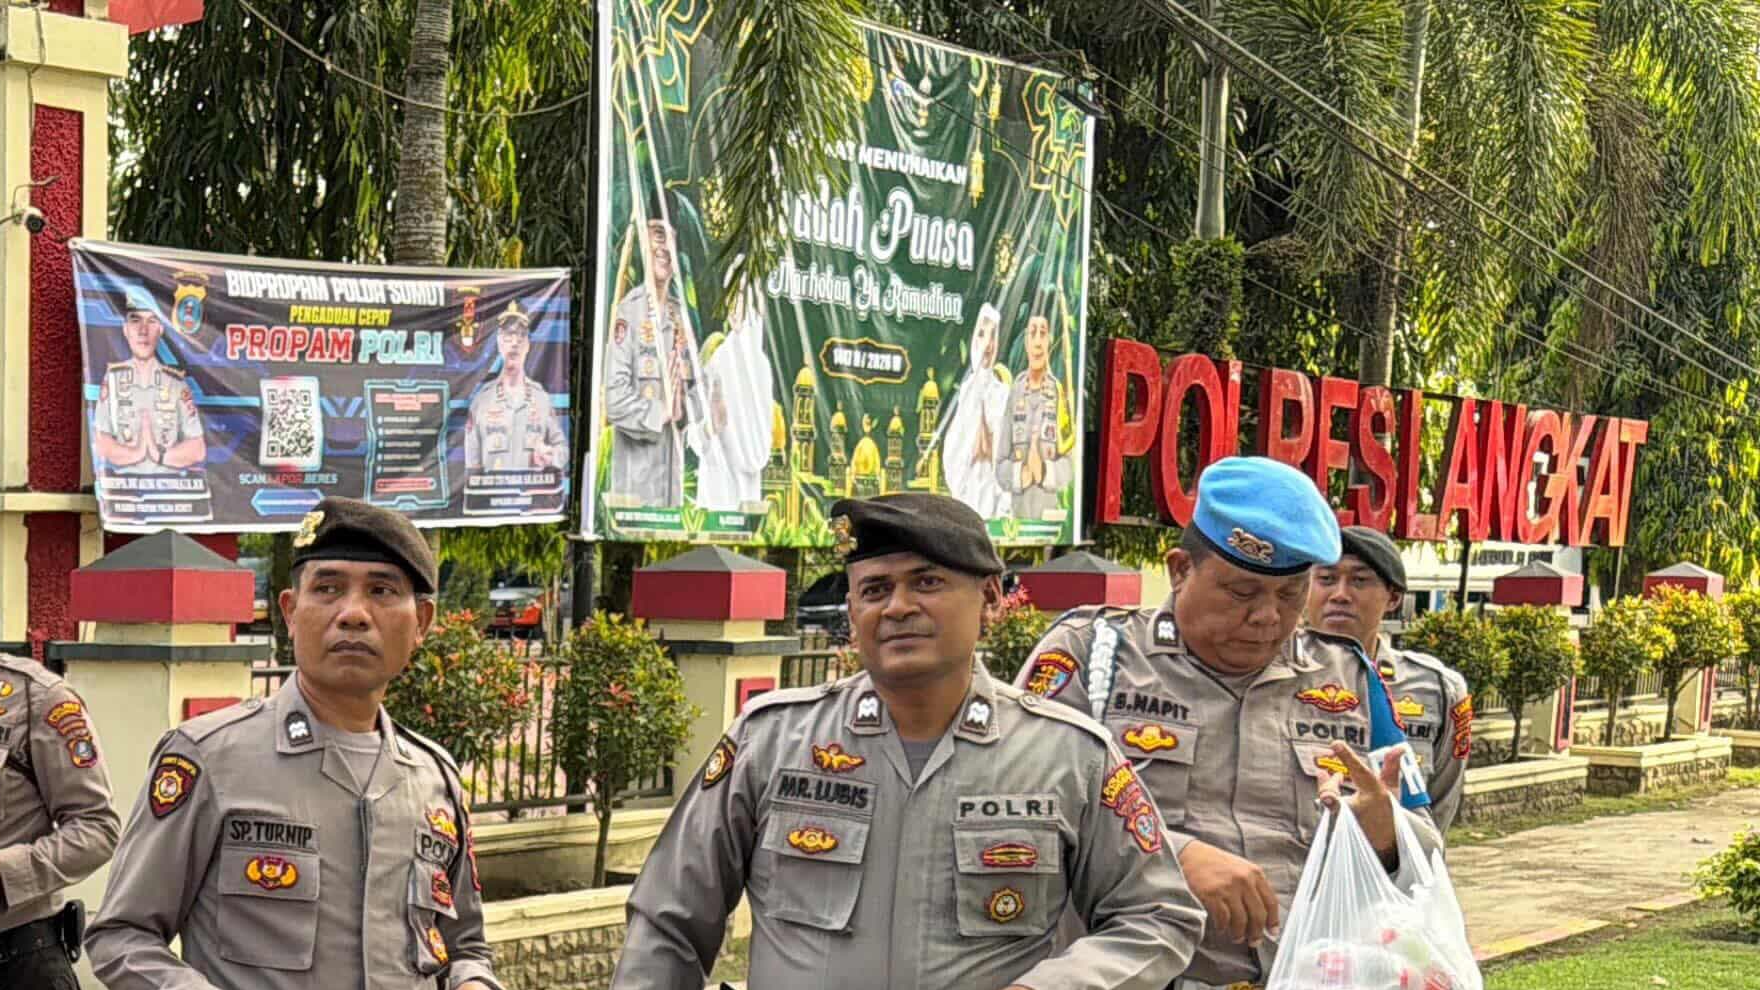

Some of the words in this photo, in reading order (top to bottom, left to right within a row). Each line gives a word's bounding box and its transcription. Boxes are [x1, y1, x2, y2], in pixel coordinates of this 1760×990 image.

[859, 147, 967, 183] MENUNAIKAN
[869, 188, 975, 270] Puasa
[225, 270, 329, 301] BIDPROPAM
[330, 277, 388, 305] POLDA
[290, 305, 356, 325] PENGADUAN
[358, 309, 392, 327] CEPAT
[226, 325, 354, 362] PROPAM
[358, 328, 444, 365] POLRI
[1400, 388, 1649, 547] LANGKAT
[1295, 720, 1366, 745] POLRI
[779, 775, 811, 799] MR.
[959, 800, 1054, 818] POLRI
